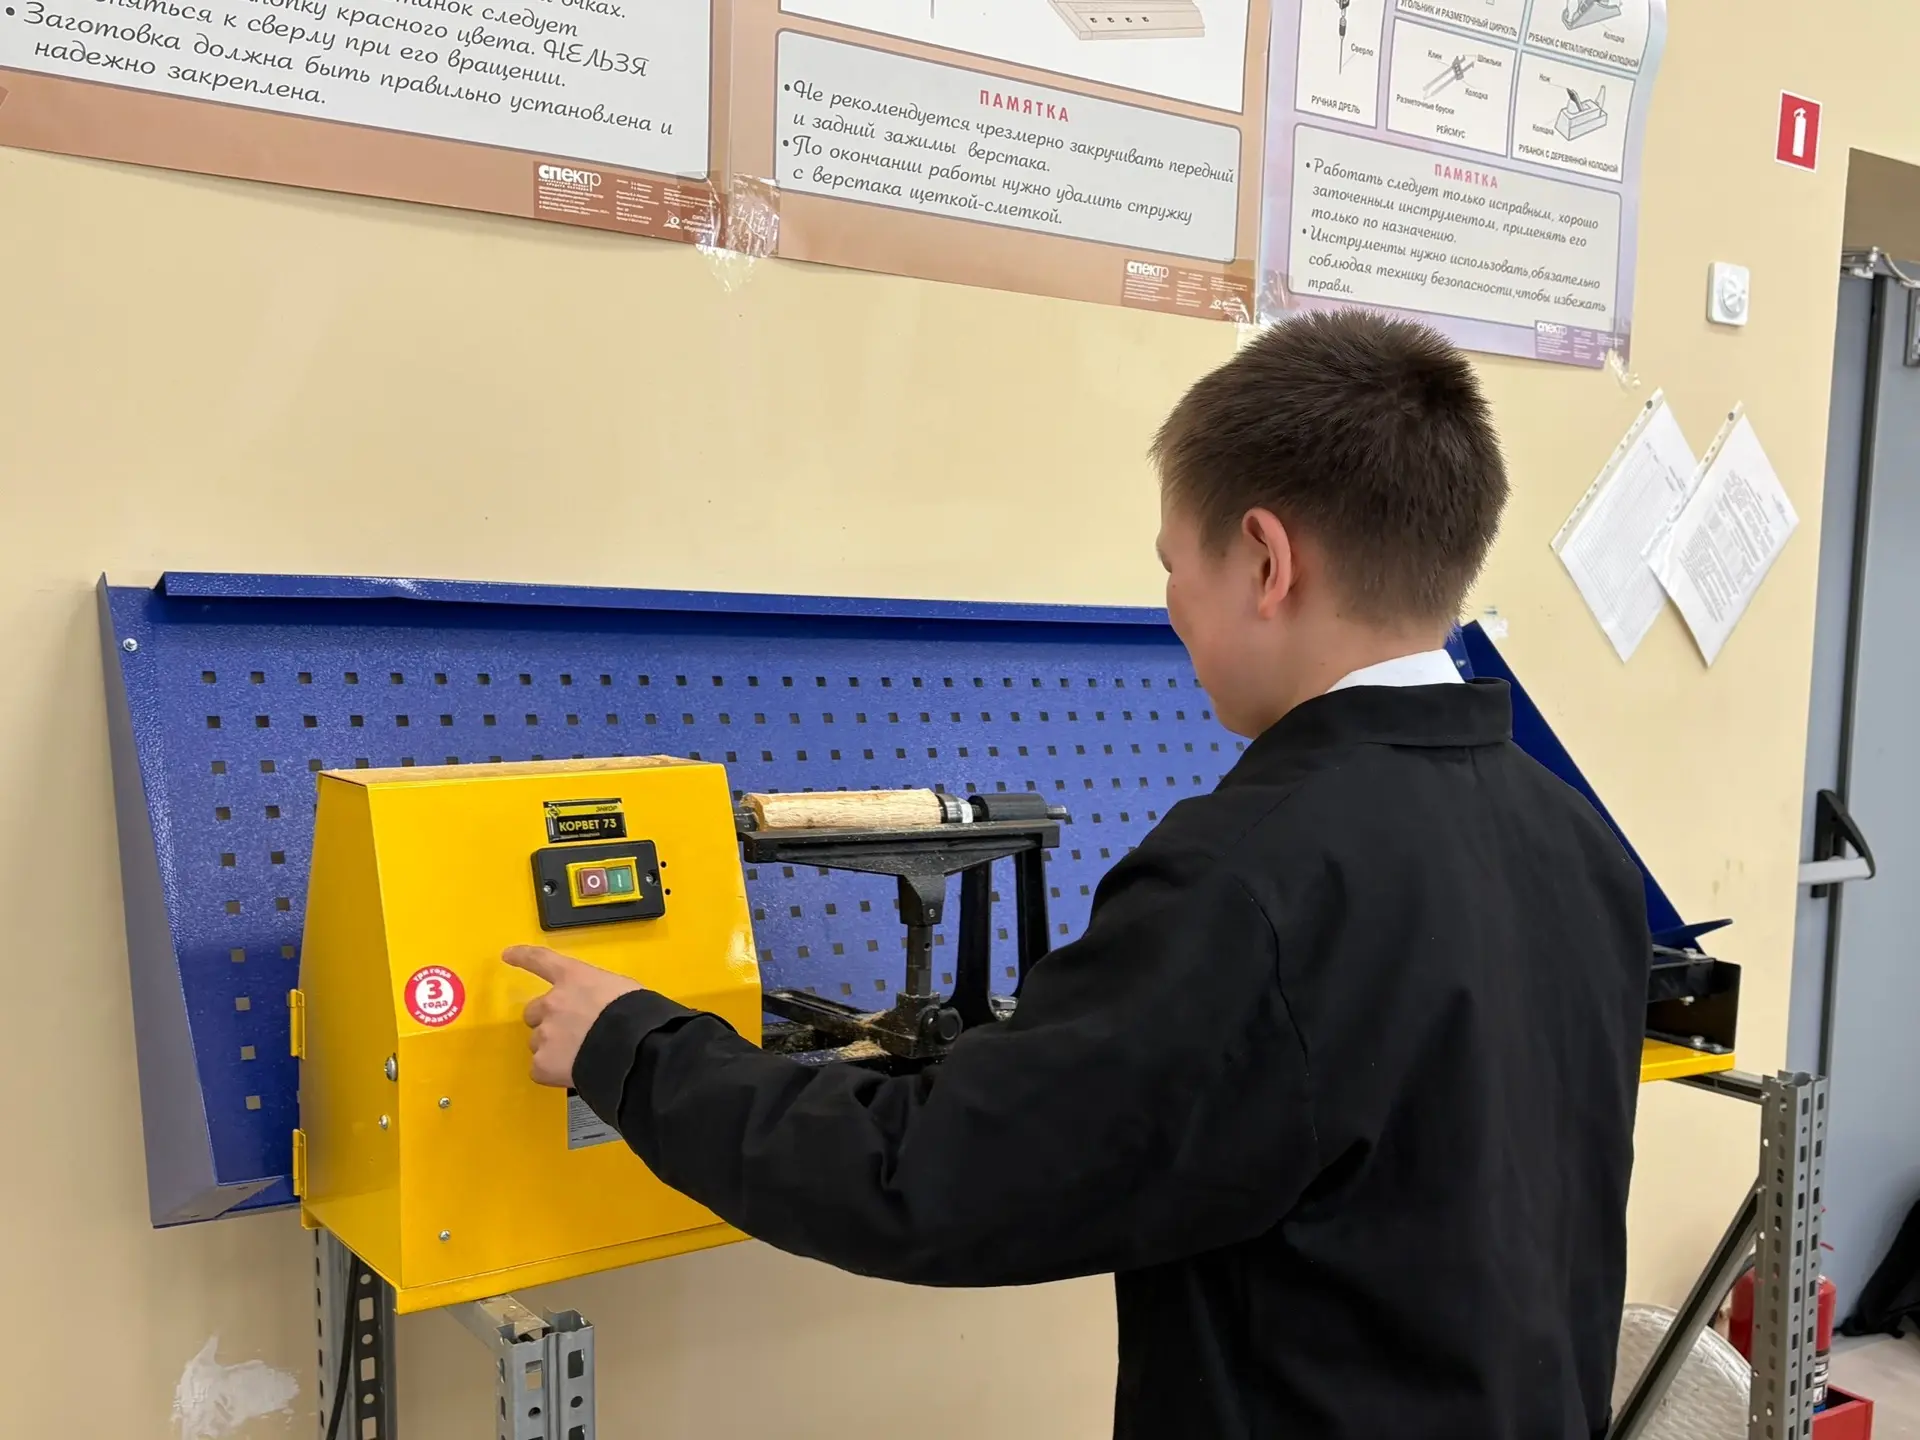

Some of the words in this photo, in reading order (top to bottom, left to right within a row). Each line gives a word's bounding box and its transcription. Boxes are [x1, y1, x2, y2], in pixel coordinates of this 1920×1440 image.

[249, 0, 327, 20] опку
[337, 7, 448, 38] красного
[457, 26, 535, 55] цвета.
[543, 39, 649, 77] НЕЛЬЗЯ
[482, 8, 578, 37] следует
[223, 13, 237, 28] к
[247, 14, 336, 50] сверлу
[345, 36, 391, 57] при
[400, 46, 439, 64] его
[447, 49, 565, 87] вращении.
[1351, 43, 1374, 56] Сверло
[23, 1, 181, 50] Заготовка
[193, 32, 293, 70] должна
[305, 55, 370, 83] быть
[380, 73, 501, 104] правильно
[510, 95, 651, 131] установлена
[660, 122, 673, 135] и
[34, 40, 156, 74] надежно
[167, 65, 326, 104] закреплена.
[980, 89, 1069, 122] ПАМЯТКА
[1311, 95, 1337, 108] РУЧНАЯ
[1338, 101, 1360, 114] ДРЕЛЬ
[793, 80, 823, 101] Не
[829, 93, 971, 131] рекомендуется
[976, 122, 1064, 150] чрезмерно
[1069, 141, 1164, 169] закручивать
[1168, 160, 1234, 183] передний
[793, 114, 805, 126] и
[812, 114, 875, 139] задний
[884, 130, 956, 154] зажимы
[968, 141, 1050, 172] верстака.
[1436, 124, 1466, 138] РЕЙСМУС
[792, 135, 822, 156] По
[829, 147, 923, 174] окончании
[928, 164, 996, 187] работы
[1002, 178, 1051, 197] нужно
[1056, 184, 1122, 210] удалить
[1127, 201, 1193, 225] стружку
[1434, 163, 1498, 188] ПАМЯТКА
[792, 168, 804, 180] с
[812, 165, 902, 197] верстака
[909, 186, 1062, 224] щеткой-сметкой.
[1314, 158, 1383, 186] Работать
[1387, 177, 1439, 197] следует
[1442, 191, 1486, 207] только
[1488, 199, 1555, 222] исправным,
[1558, 213, 1599, 230] хорошо
[1311, 207, 1359, 225] только
[1363, 217, 1379, 229] по
[1382, 220, 1457, 243] назначению.
[1312, 185, 1394, 210] заточенным
[1398, 202, 1499, 232] инструментом,
[1503, 222, 1566, 243] применять
[1569, 235, 1587, 248] его
[1310, 225, 1406, 256] Инструменты
[1409, 248, 1447, 262] нужно
[1307, 278, 1354, 294] травм.
[1308, 254, 1372, 274] соблюдая
[1376, 265, 1428, 286] технику
[1553, 293, 1606, 312] избежать
[559, 819, 600, 832] КОРВЕТ
[603, 818, 617, 829] 73
[422, 1000, 449, 1009] года
[426, 979, 443, 1000] 3
[414, 1005, 459, 1024] гарантии
